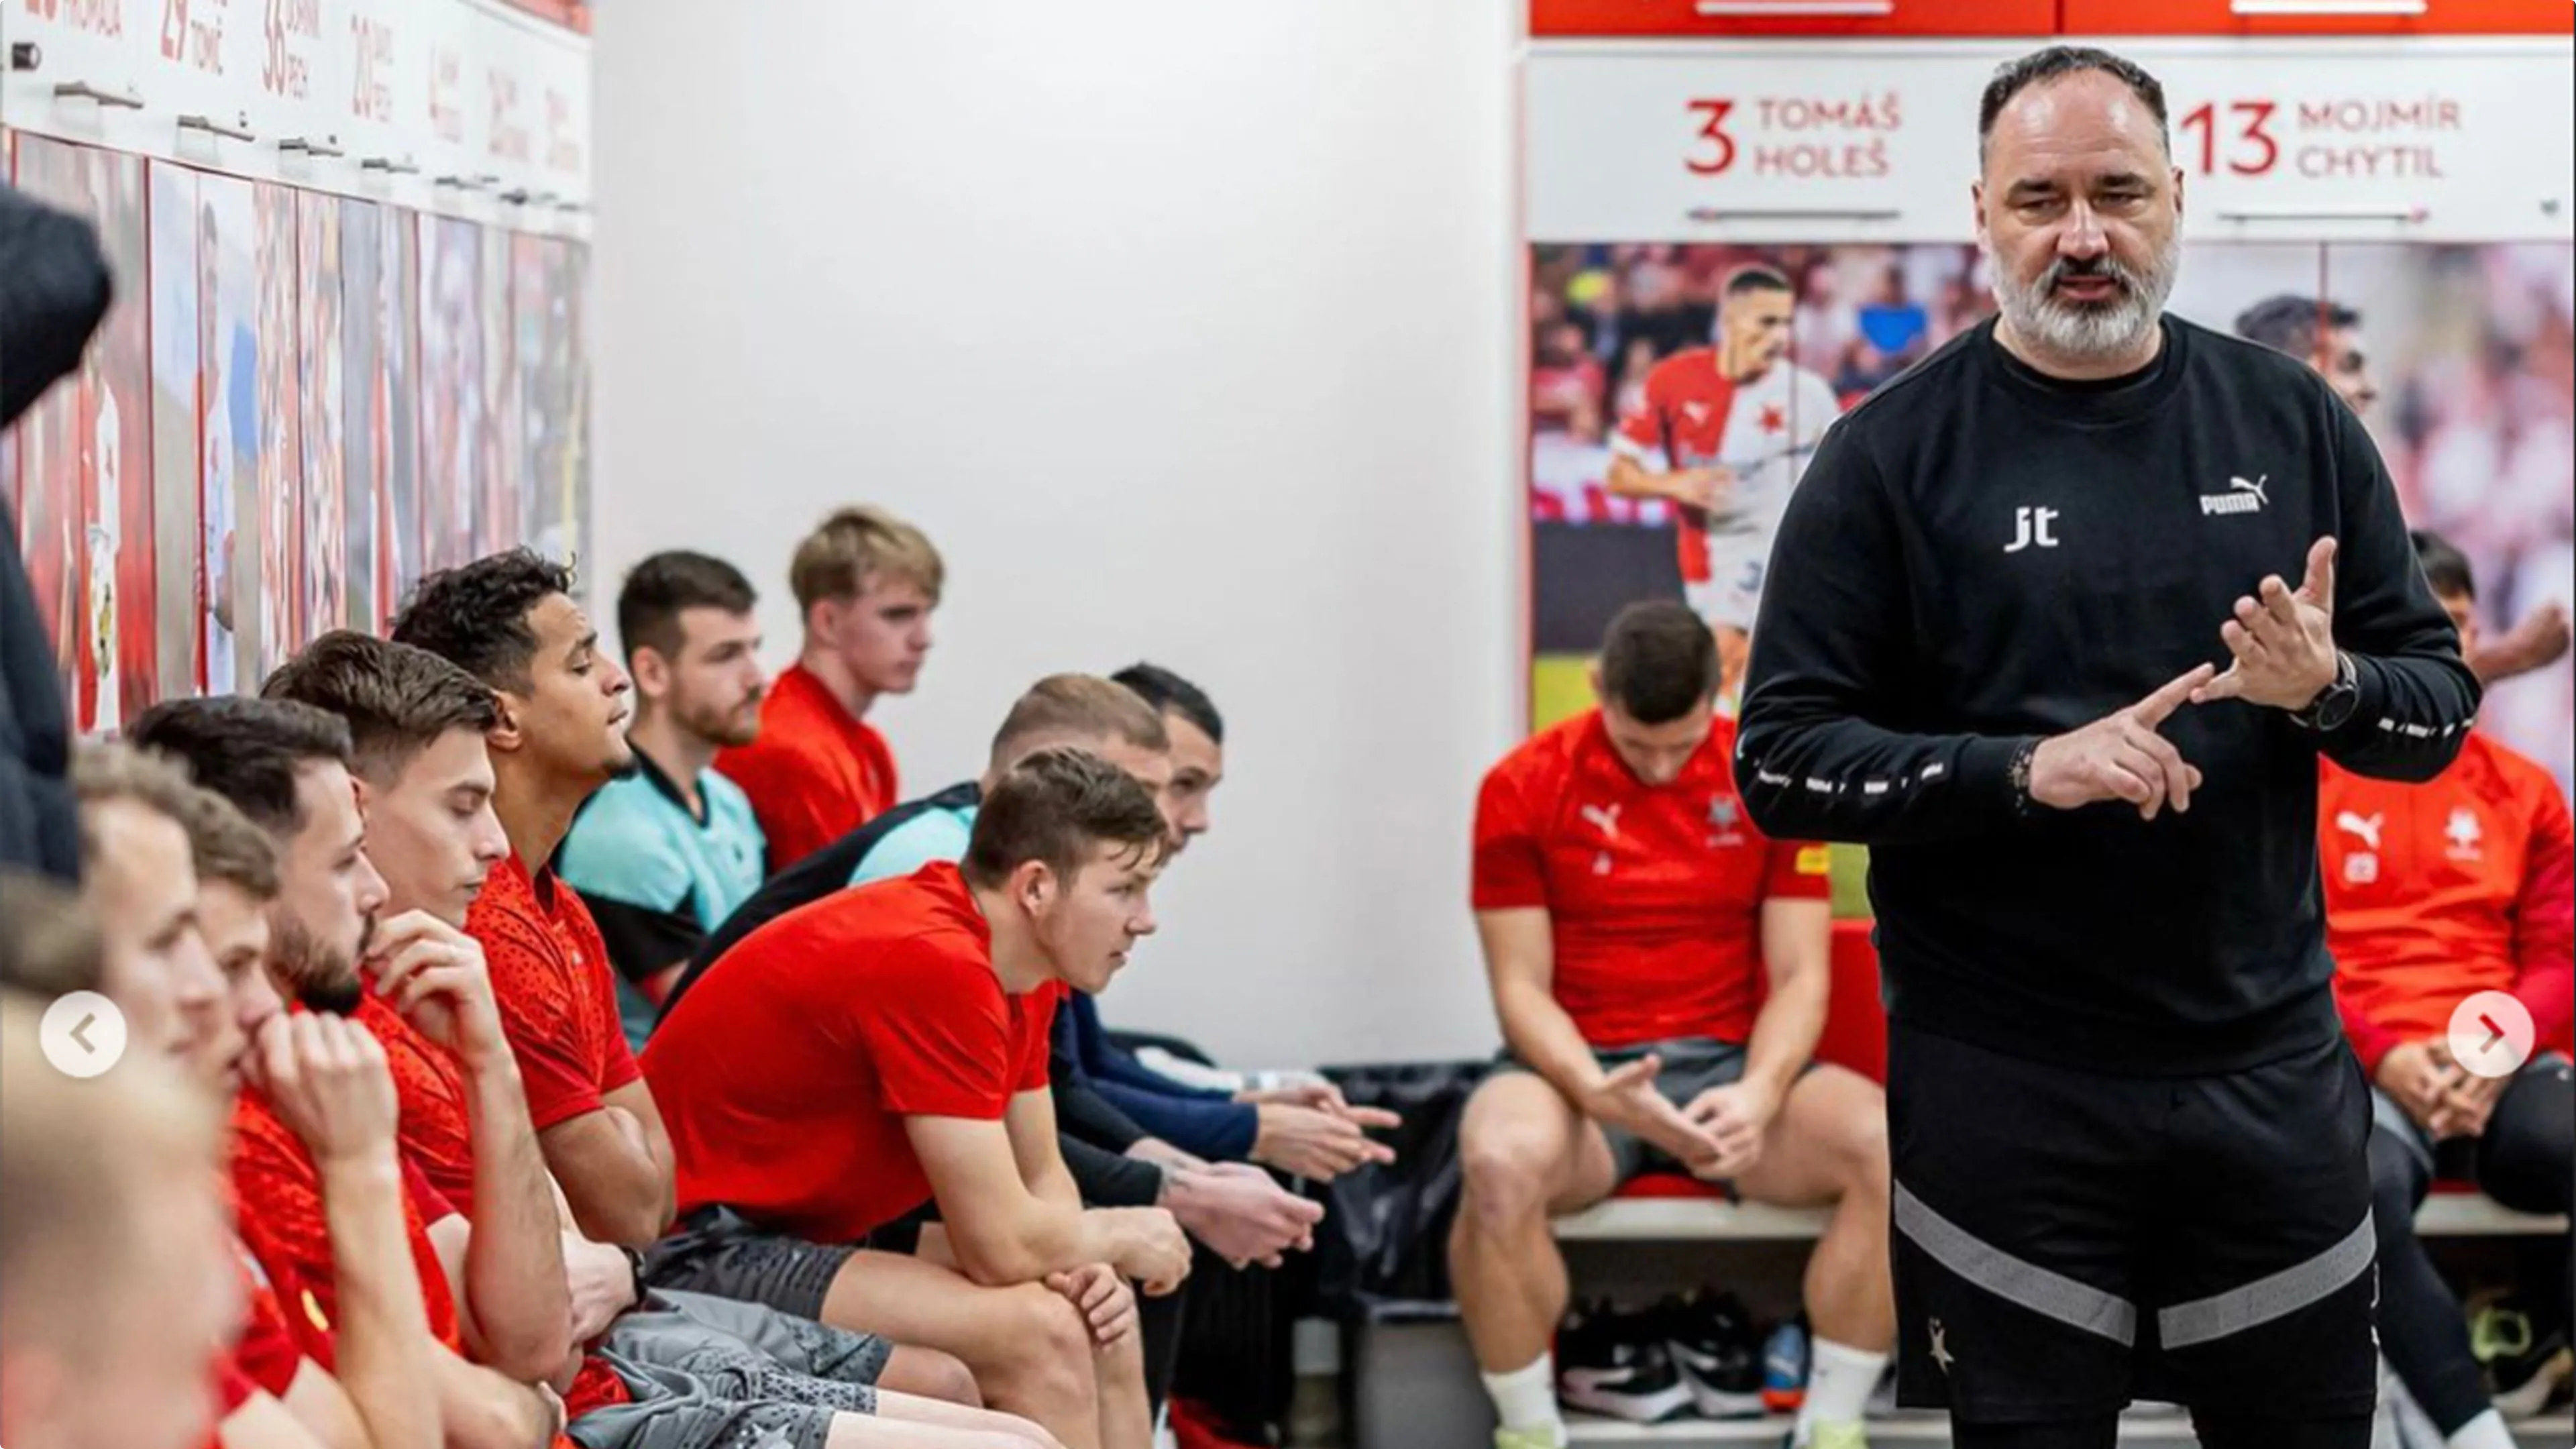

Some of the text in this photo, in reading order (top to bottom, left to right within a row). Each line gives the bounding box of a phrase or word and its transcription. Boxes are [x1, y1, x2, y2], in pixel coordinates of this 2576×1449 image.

[1754, 91, 1901, 131] TOMÁŠ
[2297, 93, 2461, 131] MOJMÍR
[1685, 99, 1736, 176] 3
[2181, 101, 2278, 176] 13
[1754, 142, 1890, 178] HOLEŠ
[2296, 145, 2444, 178] CHYTIL
[2200, 492, 2260, 515] PUMA
[2004, 506, 2059, 552] jt
